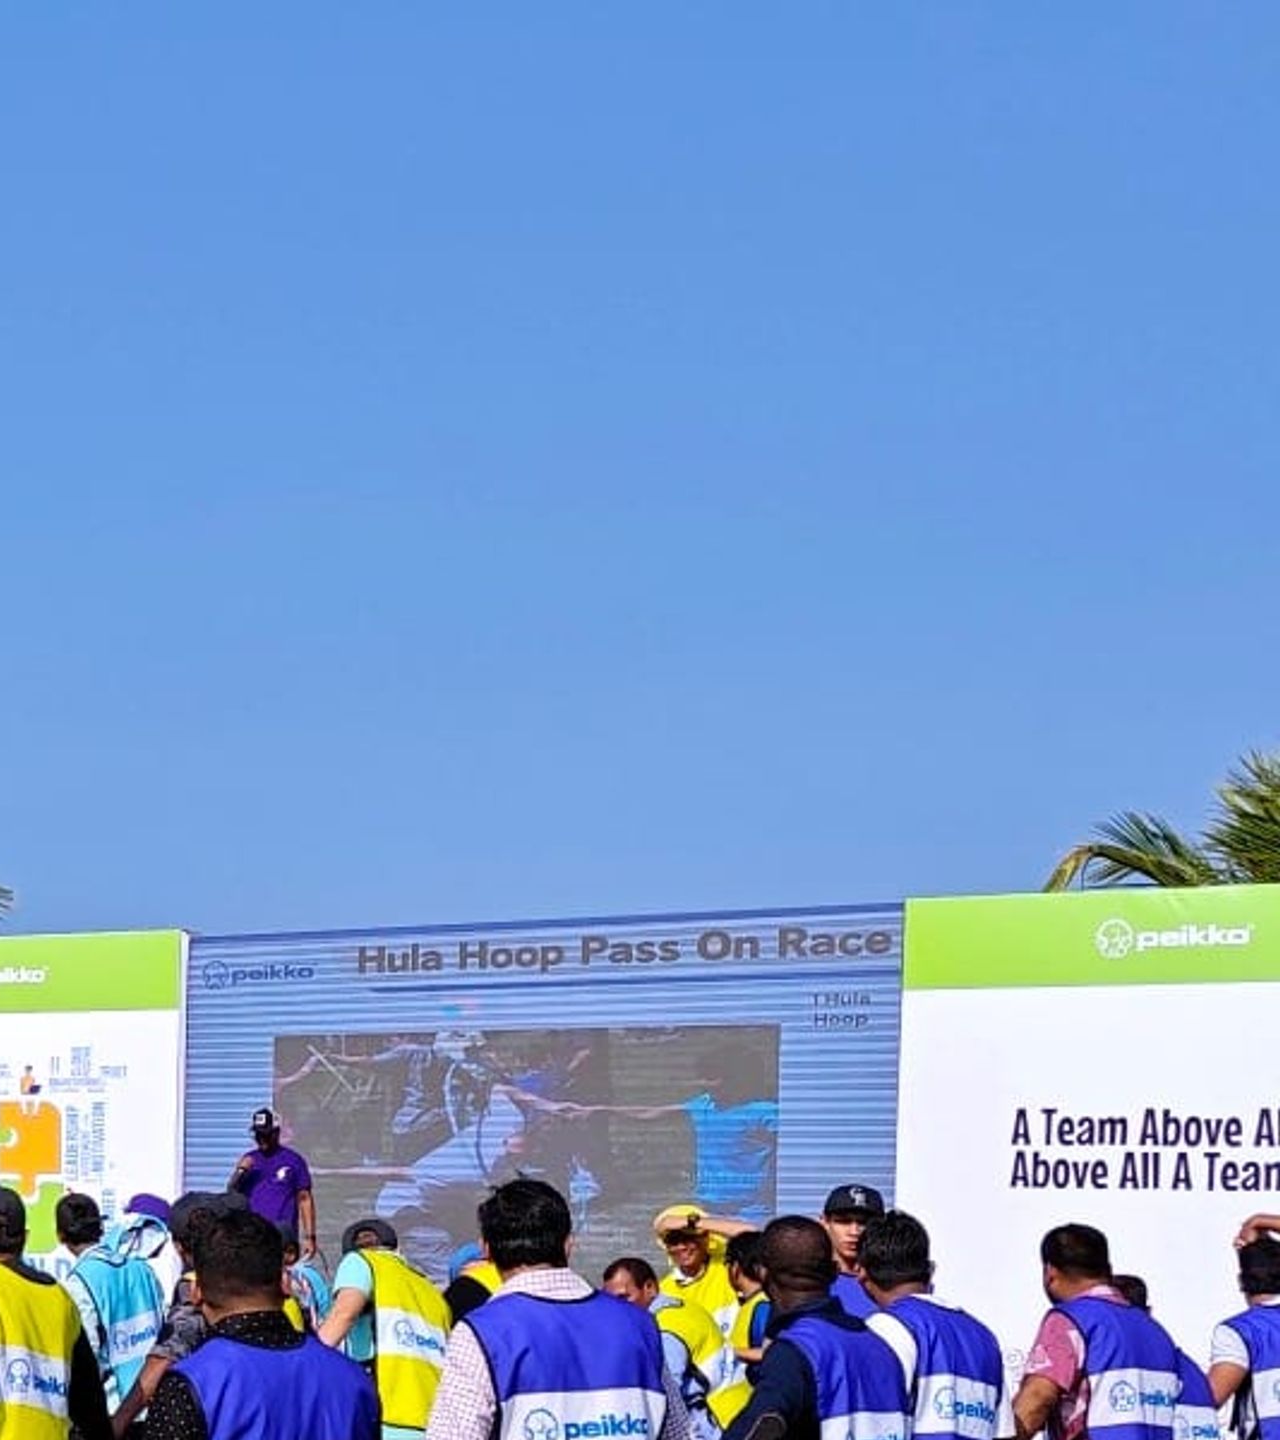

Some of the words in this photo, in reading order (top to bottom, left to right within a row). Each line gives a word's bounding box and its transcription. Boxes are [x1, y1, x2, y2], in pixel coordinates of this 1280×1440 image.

[357, 943, 442, 973] Hula
[458, 940, 564, 972] Hoop
[580, 935, 681, 966] Pass
[696, 930, 760, 961] On
[777, 926, 892, 959] Race
[1136, 924, 1251, 952] peikko
[230, 963, 315, 986] peikko
[813, 1012, 869, 1029] Hoop
[1011, 1108, 1032, 1146] A
[1041, 1108, 1129, 1147] Team
[1138, 1107, 1244, 1149] Above
[1010, 1150, 1108, 1190] Above
[1118, 1152, 1161, 1190] All
[1172, 1152, 1193, 1191] A
